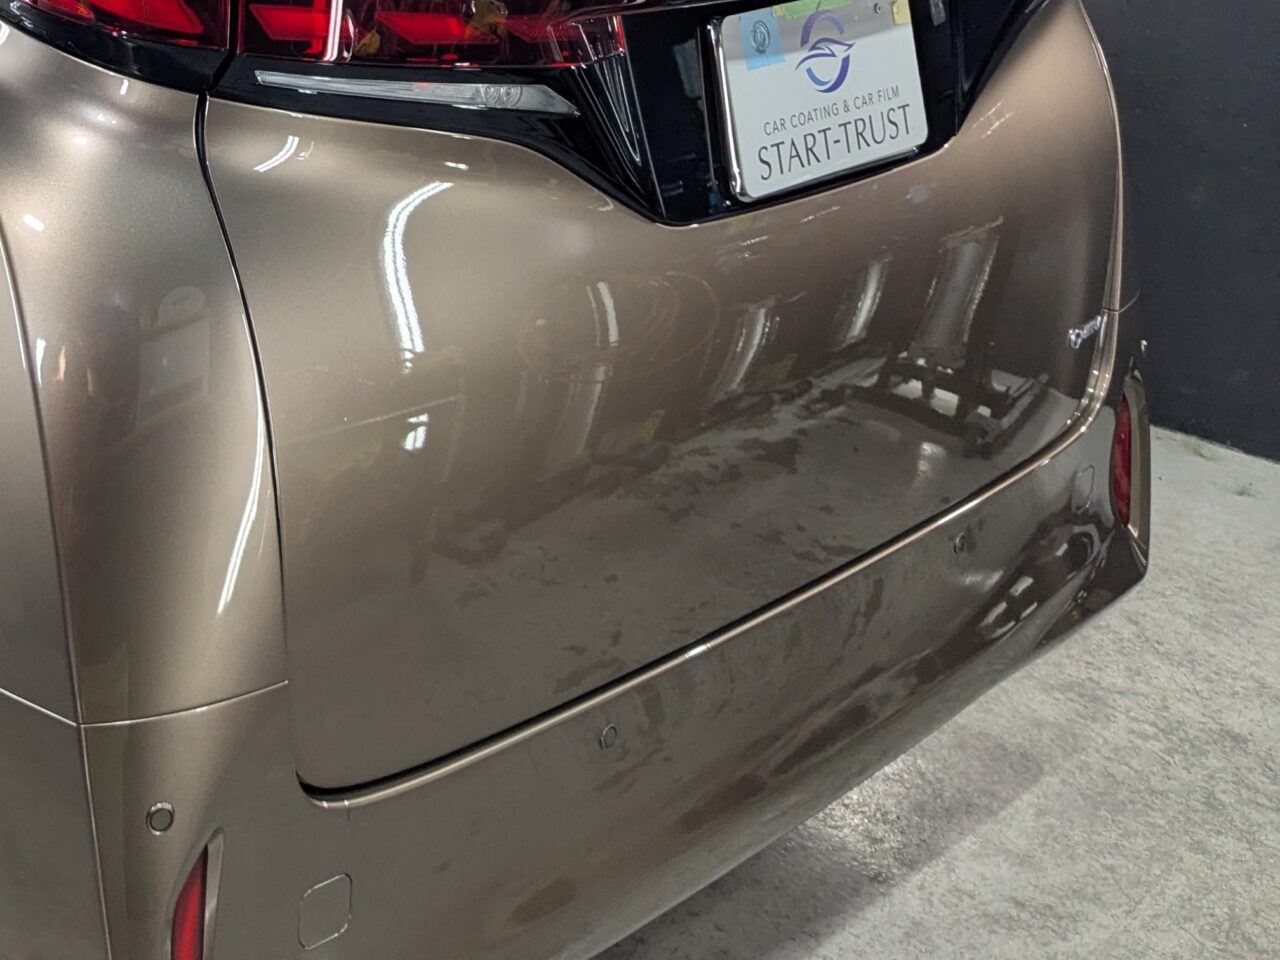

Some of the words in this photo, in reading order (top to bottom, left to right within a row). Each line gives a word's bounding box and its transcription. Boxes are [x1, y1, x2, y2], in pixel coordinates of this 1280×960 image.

[757, 103, 912, 181] START-TRUST
[763, 119, 787, 136] CAR
[790, 103, 840, 128] COATING
[842, 99, 851, 114] &
[853, 93, 876, 110] CAR
[878, 86, 900, 102] FILM
